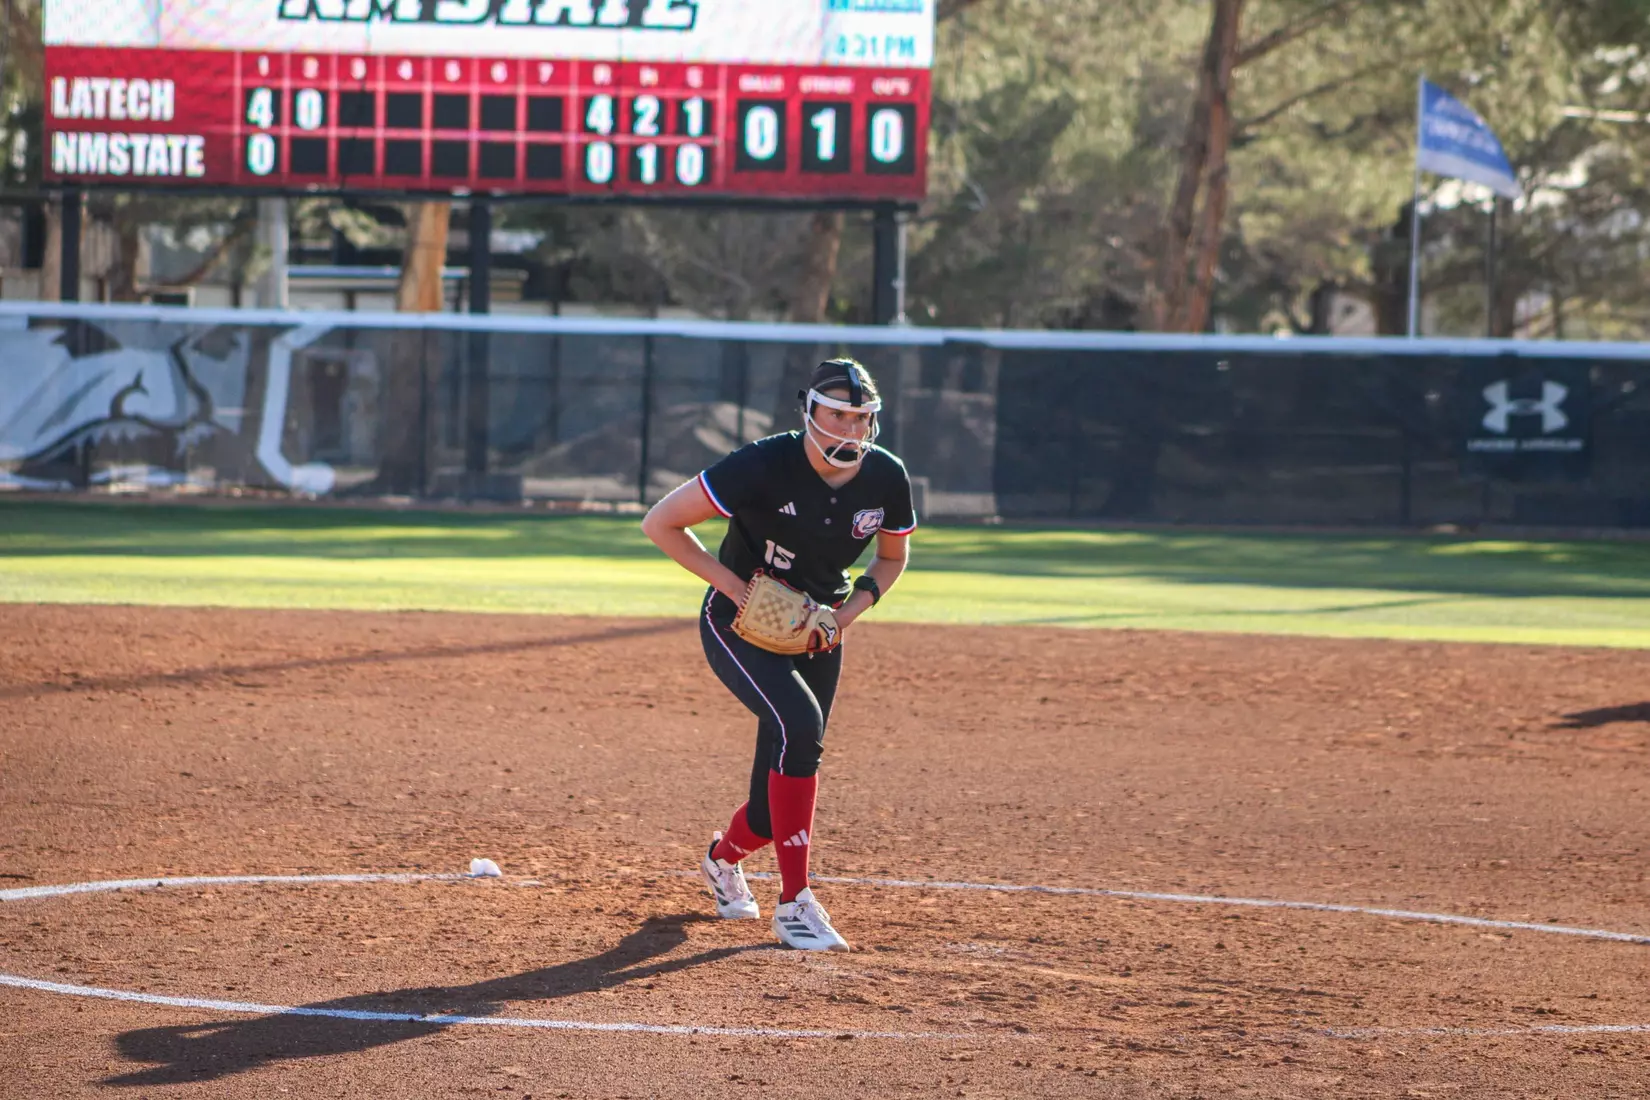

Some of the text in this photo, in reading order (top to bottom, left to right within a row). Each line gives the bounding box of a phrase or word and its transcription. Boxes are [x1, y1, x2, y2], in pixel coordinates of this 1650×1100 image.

[51, 76, 703, 137] LATECH 4 0 4 2 1
[745, 106, 903, 163] 0 1 0
[52, 131, 703, 186] NMSTATE 0 0 1 0
[765, 540, 796, 570] 15
